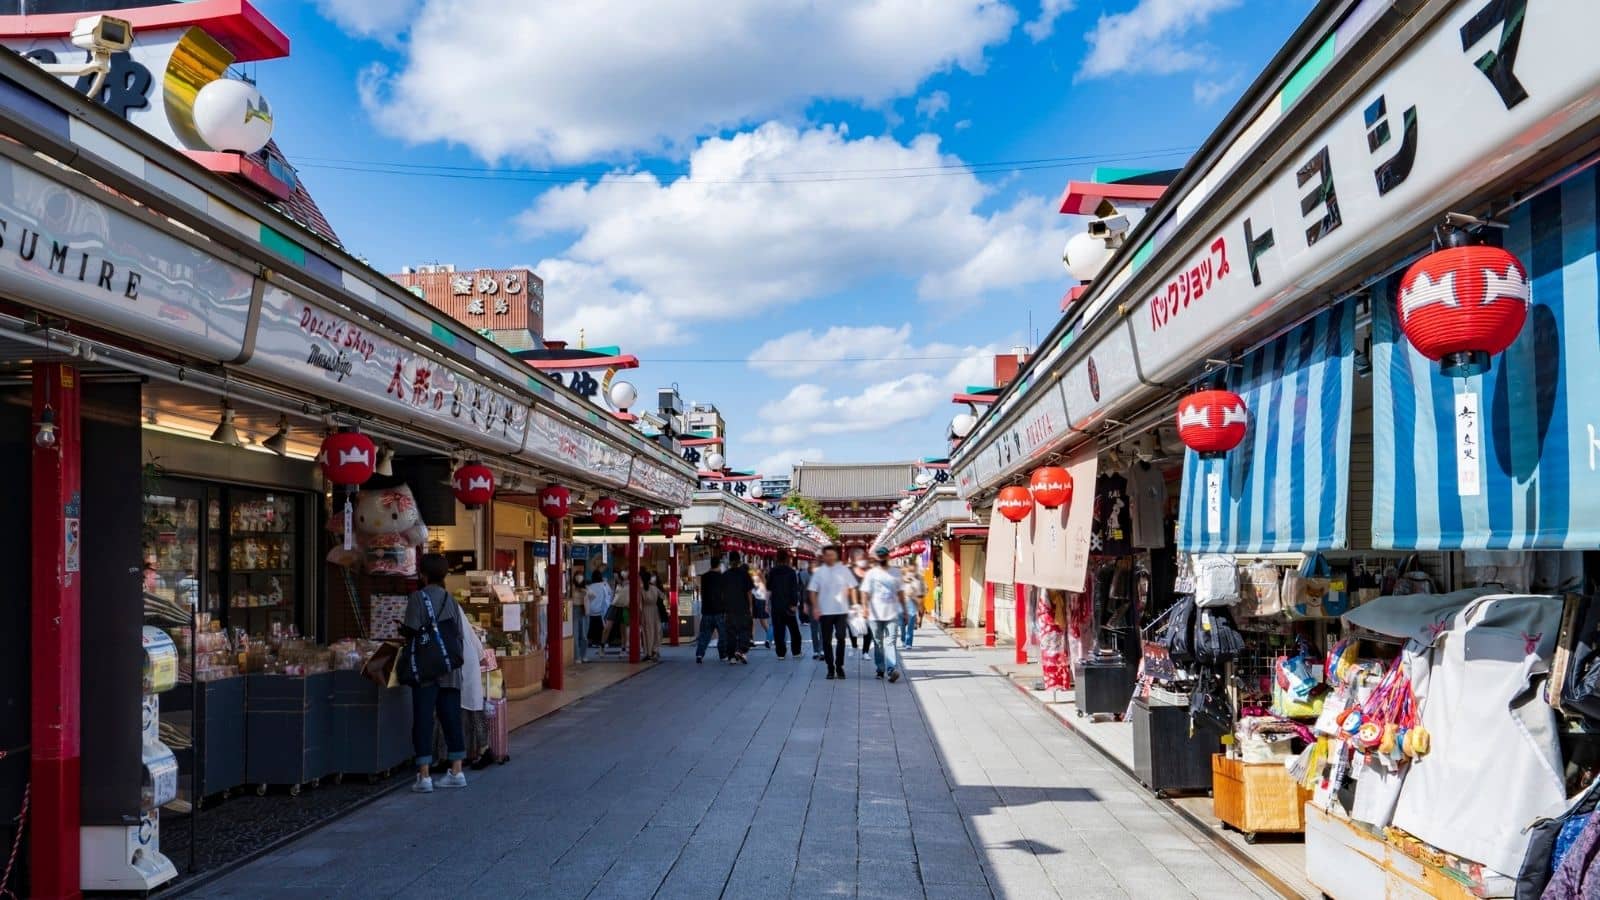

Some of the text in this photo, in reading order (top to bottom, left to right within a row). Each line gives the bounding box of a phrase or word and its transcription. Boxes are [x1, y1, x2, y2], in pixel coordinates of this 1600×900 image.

[1150, 0, 1529, 332] バックショップ トヨシマ
[344, 328, 375, 361] Shop
